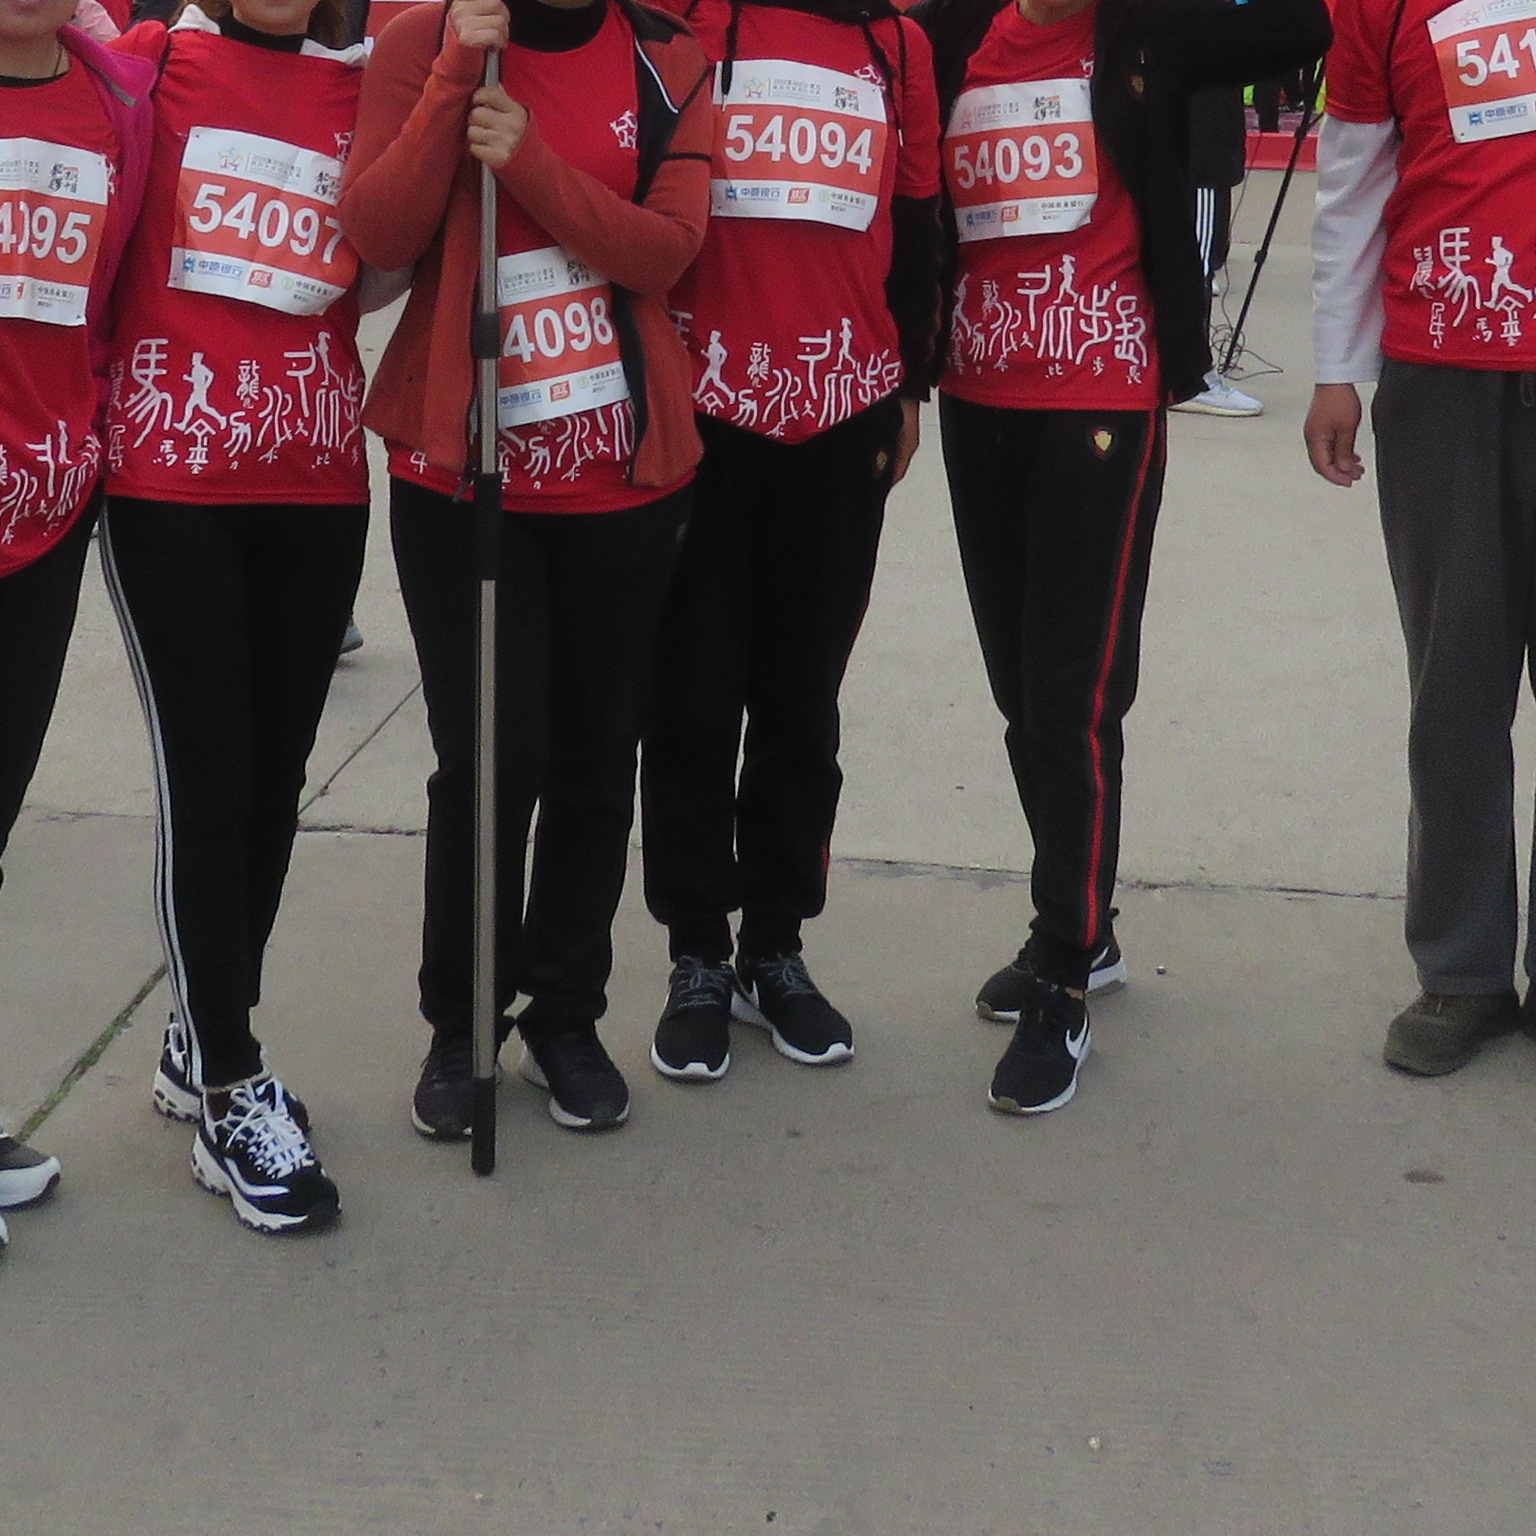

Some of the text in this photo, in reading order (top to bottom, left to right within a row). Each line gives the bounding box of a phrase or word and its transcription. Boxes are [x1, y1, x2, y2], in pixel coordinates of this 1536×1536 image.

[725, 115, 873, 175] 54094
[955, 133, 1083, 189] 54093
[189, 183, 345, 264] 54097
